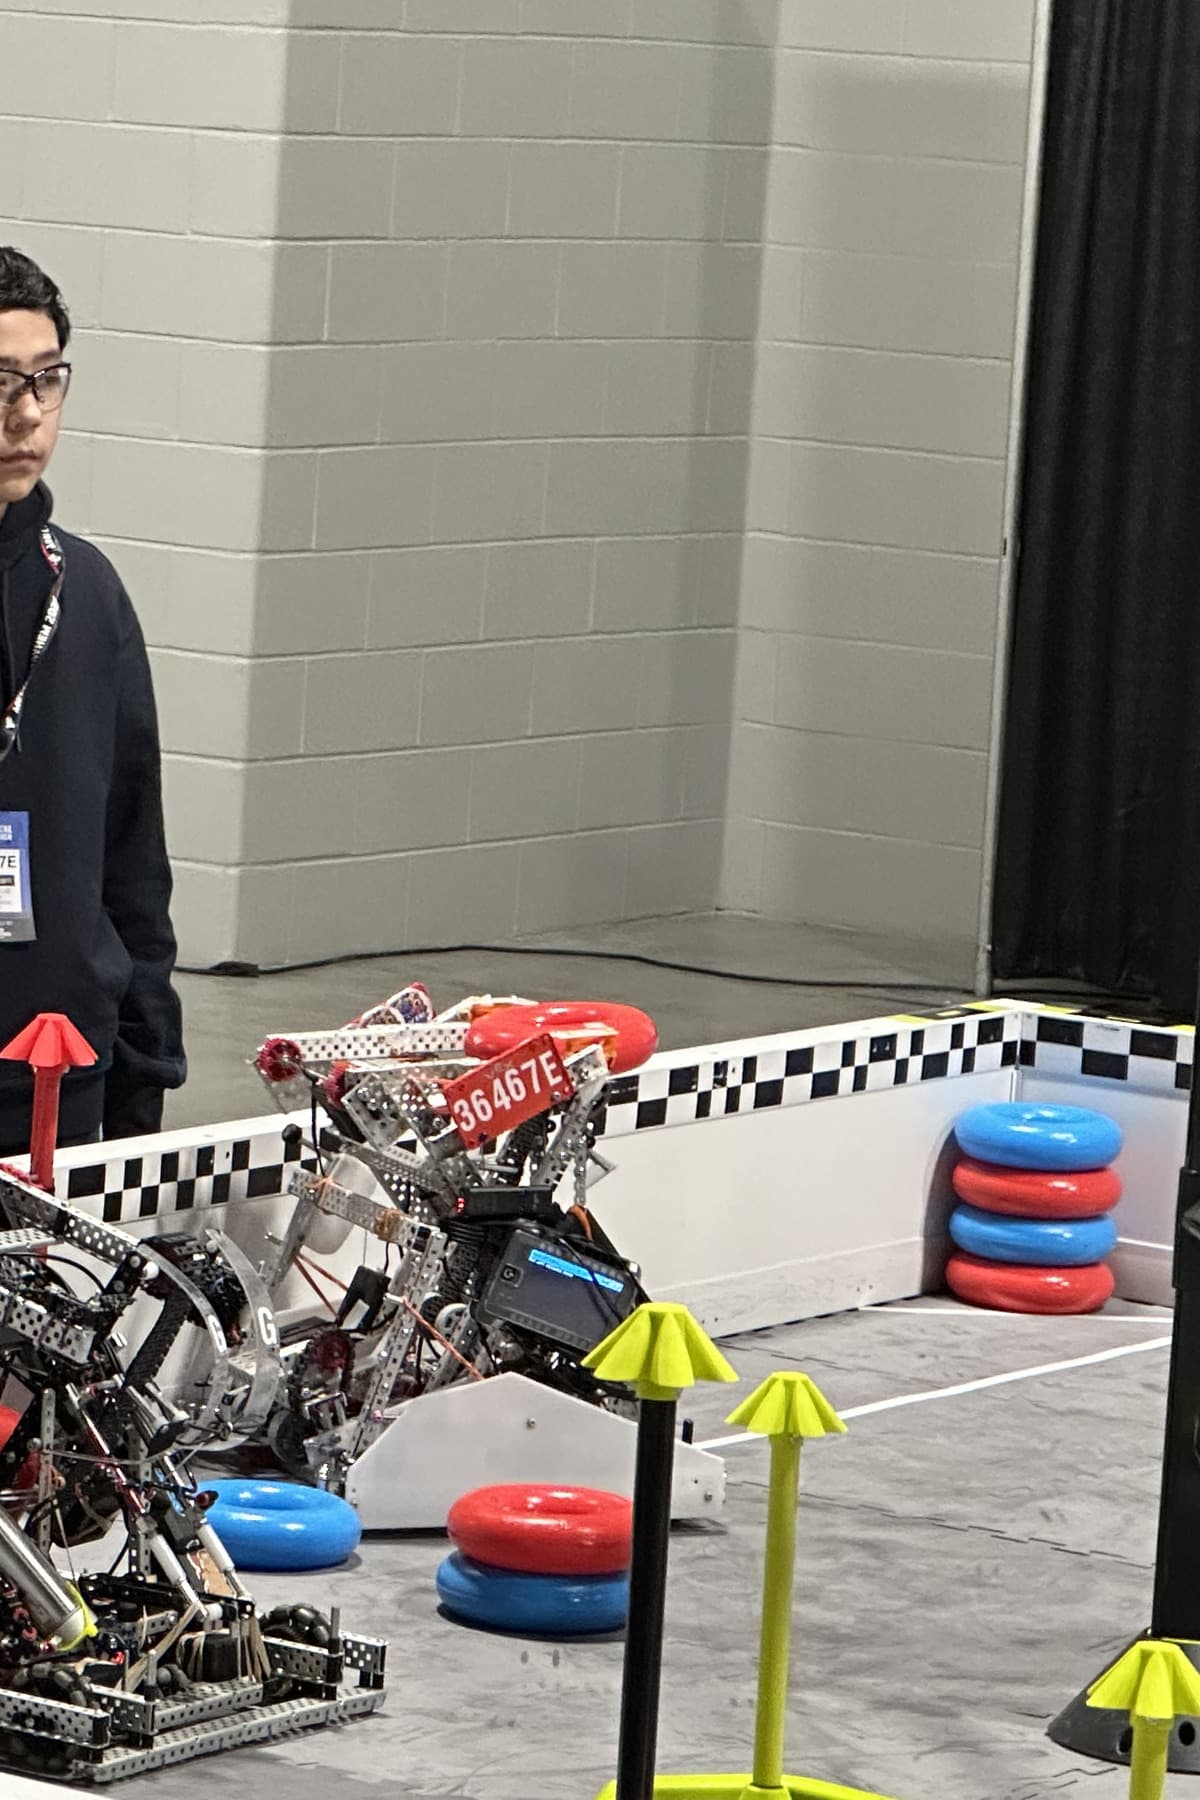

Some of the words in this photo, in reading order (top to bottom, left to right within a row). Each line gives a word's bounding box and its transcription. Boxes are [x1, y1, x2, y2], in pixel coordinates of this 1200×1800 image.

[453, 1049, 563, 1132] 36467E
[207, 1314, 228, 1353] G
[257, 1306, 277, 1345] G
